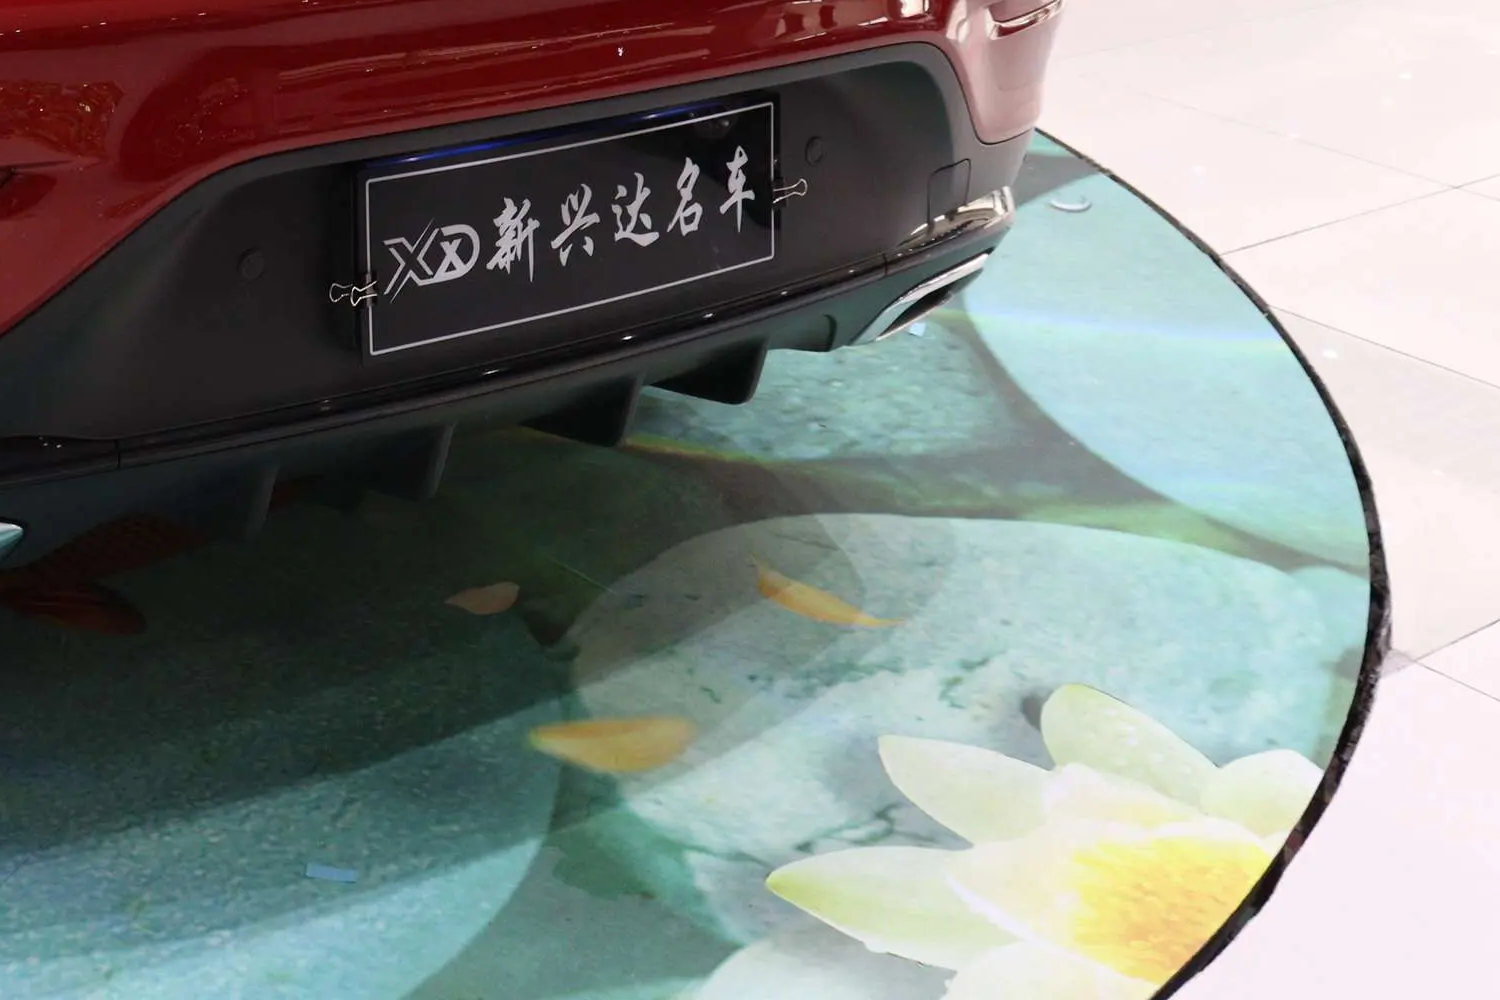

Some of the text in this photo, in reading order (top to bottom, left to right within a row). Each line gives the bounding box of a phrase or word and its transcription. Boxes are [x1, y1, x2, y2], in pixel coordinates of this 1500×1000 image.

[486, 145, 756, 283] 新兴达名车
